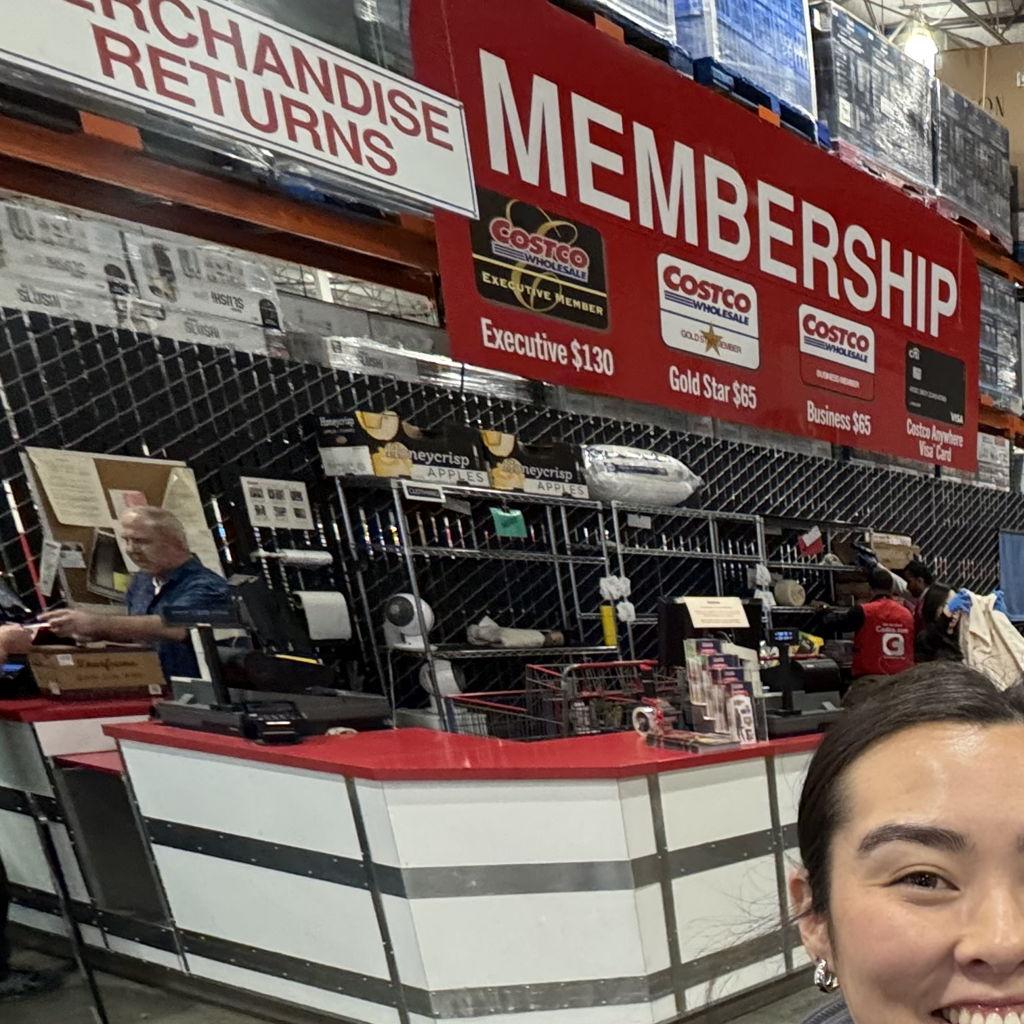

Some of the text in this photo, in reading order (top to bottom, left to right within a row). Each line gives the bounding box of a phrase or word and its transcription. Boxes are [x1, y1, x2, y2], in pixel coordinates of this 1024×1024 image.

[91, 22, 398, 176] RETURNS
[478, 48, 958, 338] MEMBERSHIP
[489, 217, 590, 269] COSTCO
[524, 252, 587, 280] WHOLESALE
[482, 271, 604, 316] EXECUTIVE MEMBER
[663, 265, 752, 314] COSTCO
[693, 300, 750, 326] WHOLESALE
[480, 317, 615, 377] Executive $130
[802, 313, 870, 353] COSTCO
[824, 342, 868, 364] WHOLESALE
[669, 365, 757, 410] Gold Star $65
[807, 399, 872, 436] Business $65
[906, 417, 964, 447] Costco Anywhere
[919, 440, 952, 462] Visa Card
[427, 467, 485, 484] APPLES
[537, 481, 585, 497] APPLES
